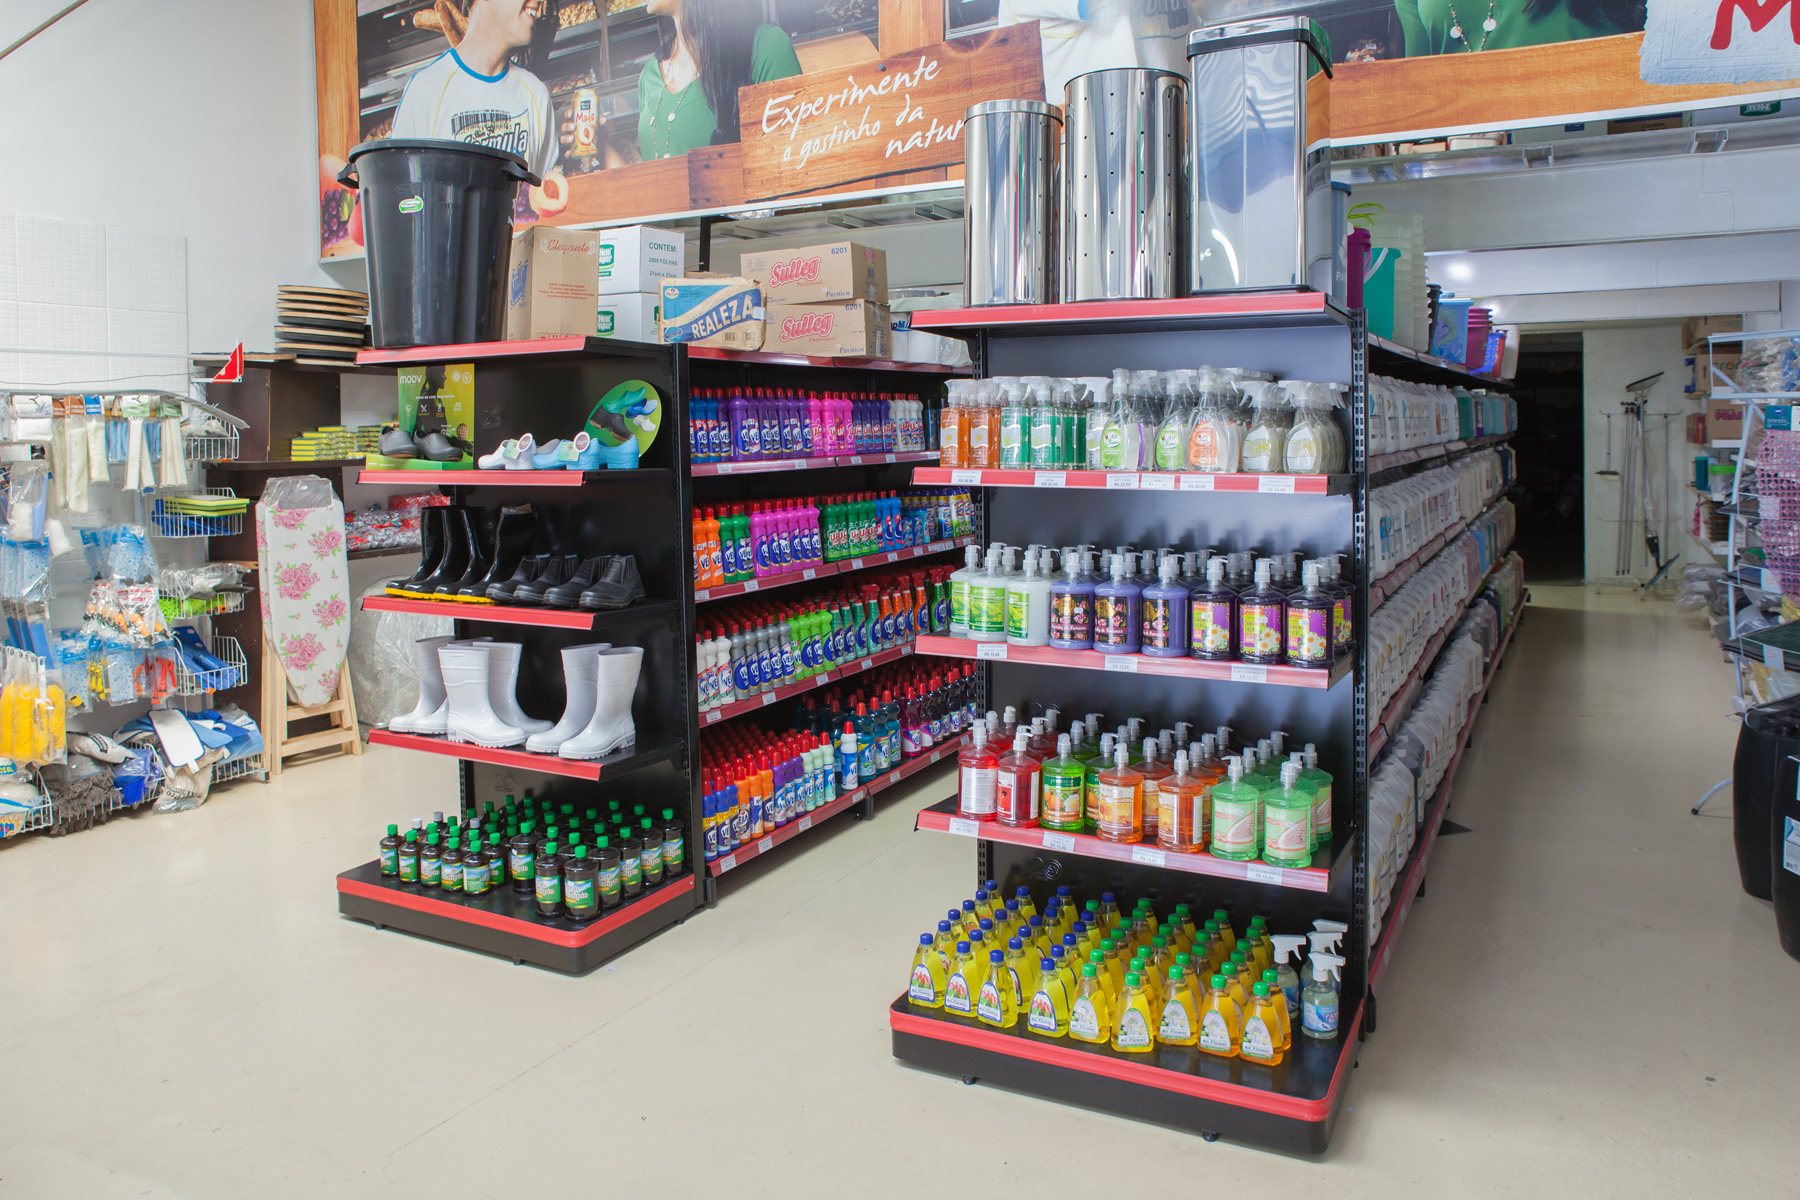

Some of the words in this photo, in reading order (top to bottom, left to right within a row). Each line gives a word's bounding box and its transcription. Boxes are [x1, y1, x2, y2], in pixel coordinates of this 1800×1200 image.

[762, 55, 942, 140] Experimente
[576, 111, 595, 124] Mais
[896, 94, 926, 126] da
[796, 106, 882, 170] gostinho
[885, 118, 965, 159] natur
[547, 239, 590, 255] Elegante
[648, 241, 678, 253] CONTÉM:
[831, 246, 848, 255] 6201
[660, 258, 678, 266] FOLHAS
[769, 256, 821, 288] Sulleg
[1336, 271, 1345, 280] PA
[845, 303, 862, 311] 6201
[691, 295, 754, 339] REALEZA
[779, 311, 834, 343] Sulleg
[400, 375, 422, 385] moov
